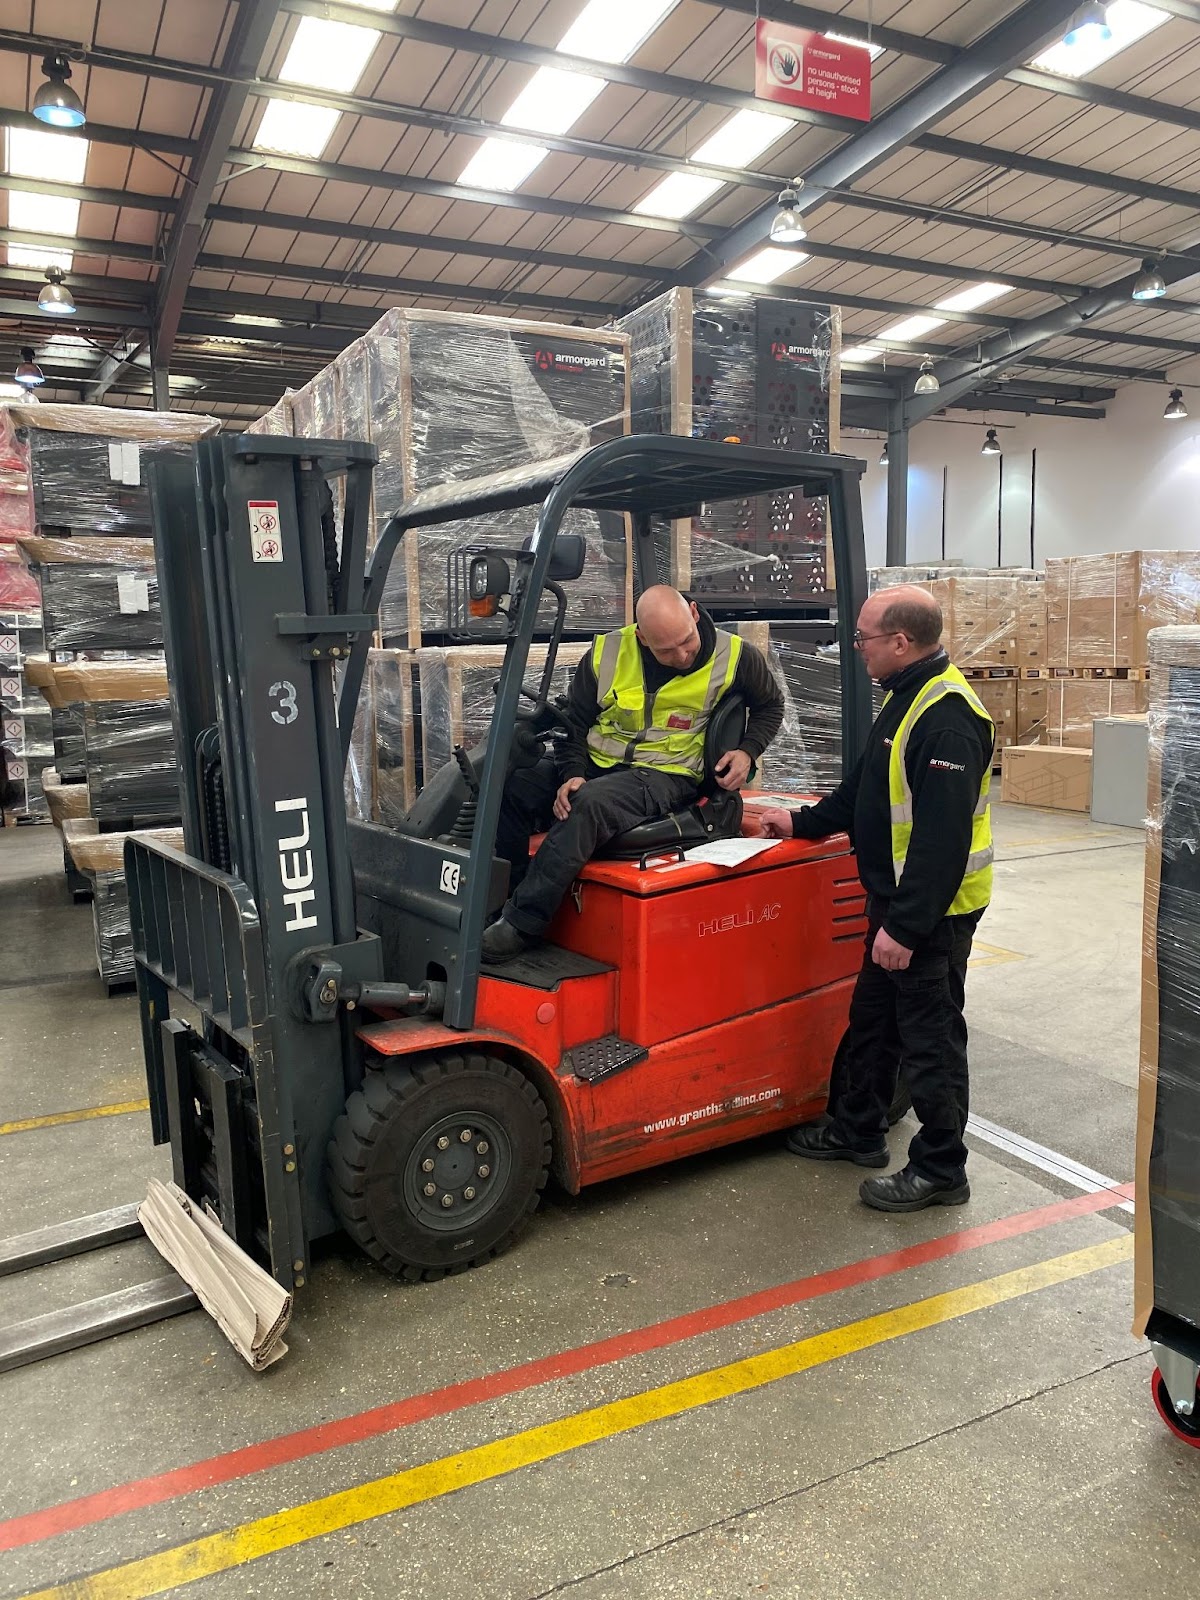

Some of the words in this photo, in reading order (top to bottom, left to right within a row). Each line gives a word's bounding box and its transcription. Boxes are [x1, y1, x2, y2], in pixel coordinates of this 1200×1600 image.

[807, 66, 817, 75] no
[818, 68, 861, 86] unauthorised
[807, 77, 835, 90] persons
[840, 84, 859, 95] stock
[807, 86, 815, 95] at
[815, 87, 837, 100] height
[555, 354, 606, 367] armorgard
[268, 680, 299, 725] 3
[929, 758, 966, 772] armorgard
[275, 797, 318, 932] HELI
[698, 909, 754, 938] HELI
[757, 902, 782, 924] AC
